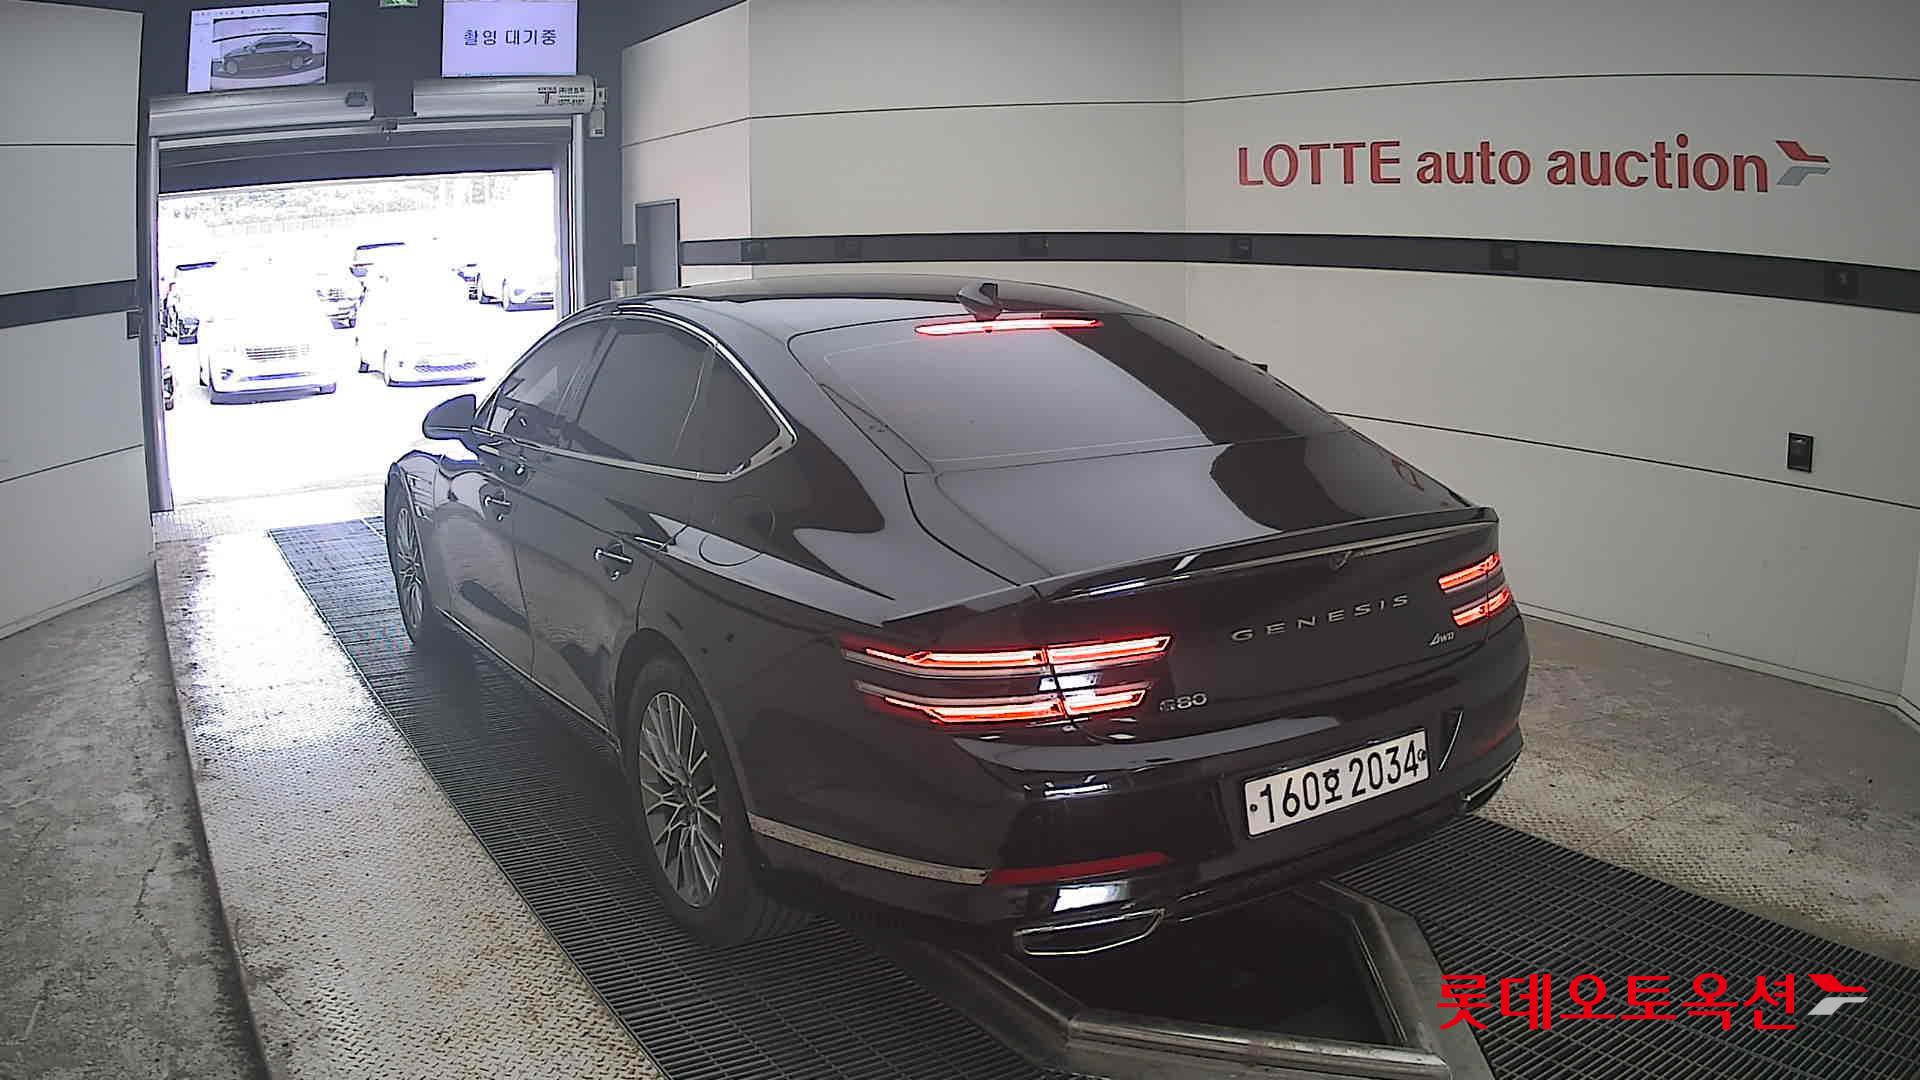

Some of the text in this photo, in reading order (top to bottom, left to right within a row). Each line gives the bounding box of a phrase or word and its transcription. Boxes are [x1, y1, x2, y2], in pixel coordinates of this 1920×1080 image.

[504, 29, 557, 46] 대기중
[1238, 133, 1769, 194] LOTTE auto auction
[1231, 594, 1409, 642] GENESIS
[1159, 692, 1208, 711] G80
[1259, 740, 1419, 823] 160호 2034
